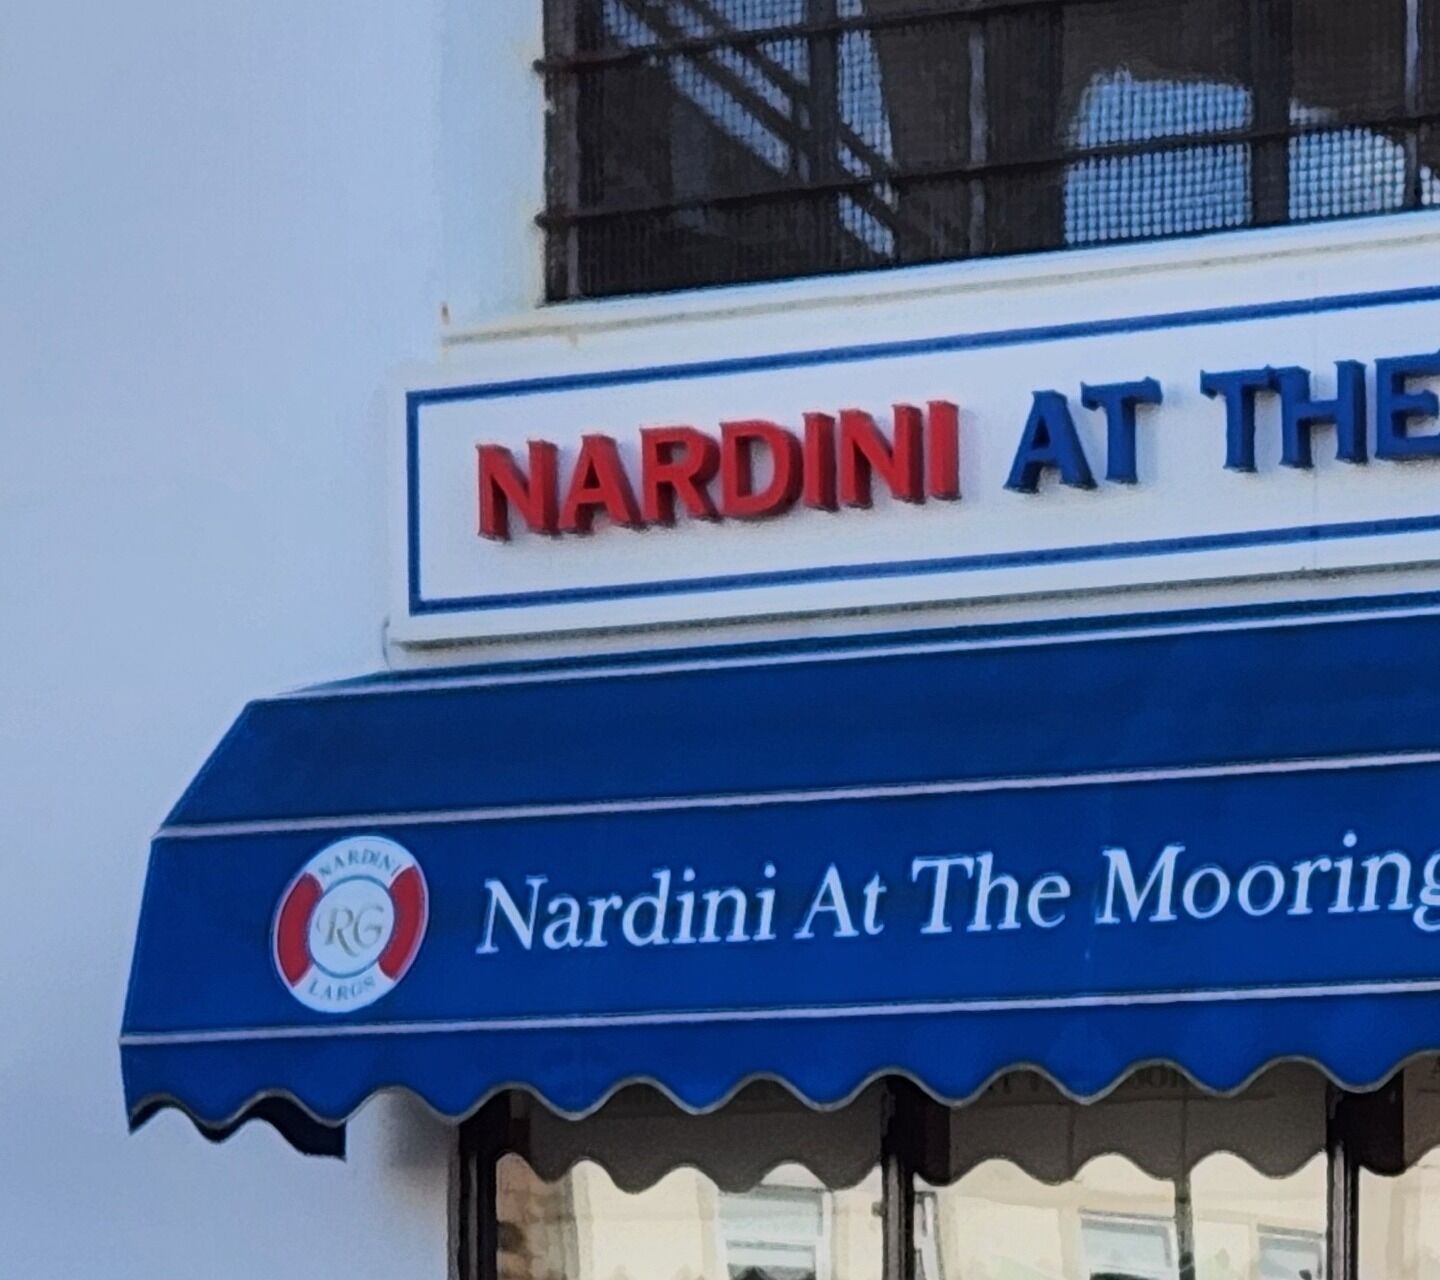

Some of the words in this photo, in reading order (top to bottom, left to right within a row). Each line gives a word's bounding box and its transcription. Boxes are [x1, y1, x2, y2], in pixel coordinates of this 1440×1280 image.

[476, 399, 961, 541] NARDINI
[1003, 376, 1163, 493] AT
[316, 902, 386, 958] RG
[476, 861, 778, 956] Nardini
[794, 862, 886, 940] At
[911, 850, 1072, 936] The
[307, 975, 377, 1002] LARGS
